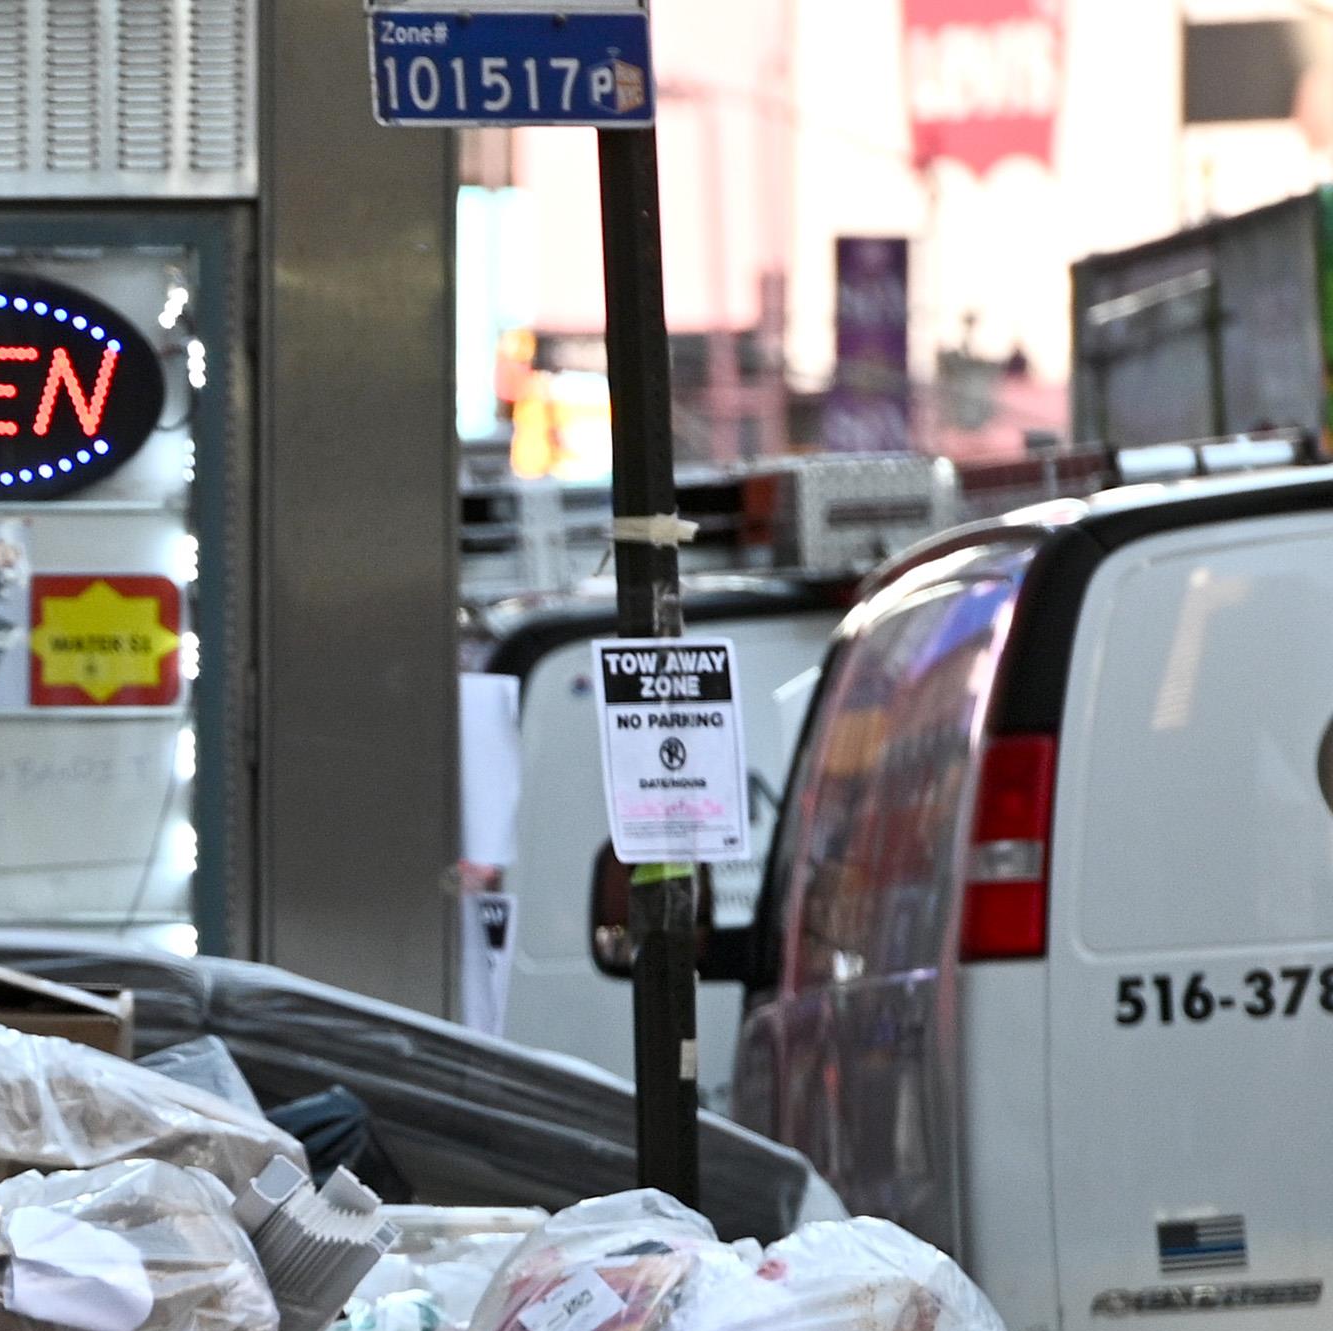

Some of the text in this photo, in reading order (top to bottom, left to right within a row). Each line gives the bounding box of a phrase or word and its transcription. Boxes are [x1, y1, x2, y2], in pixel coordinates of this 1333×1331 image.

[380, 20, 449, 45] Zone#
[383, 55, 581, 113] 101517
[604, 651, 726, 675] TOW AWAY
[639, 674, 701, 698] ZONE
[617, 711, 724, 730] NO PARKING
